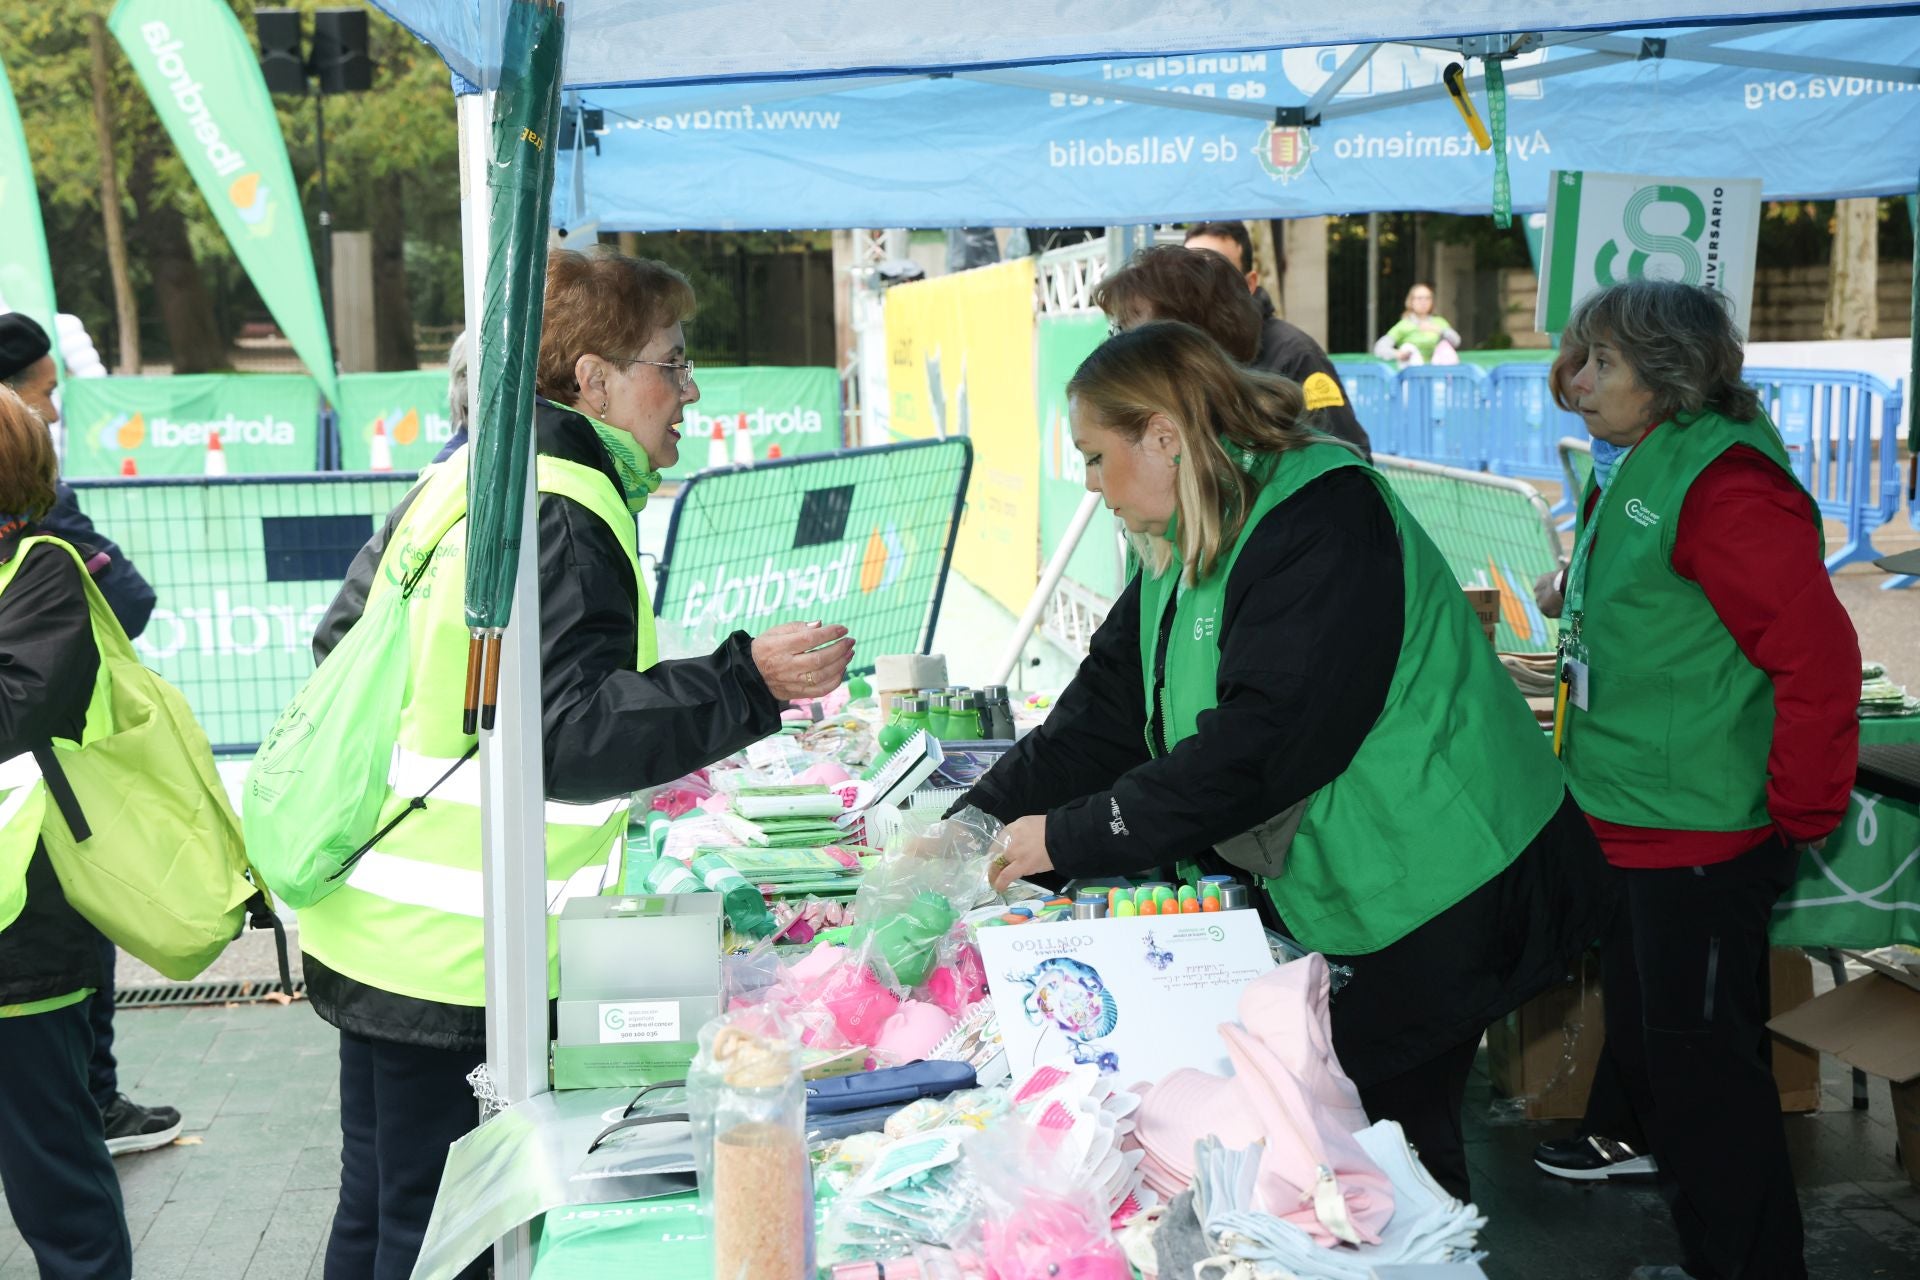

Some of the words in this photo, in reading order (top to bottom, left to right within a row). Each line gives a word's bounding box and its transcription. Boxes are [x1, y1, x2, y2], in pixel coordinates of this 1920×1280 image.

[1706, 186, 1724, 289] NIVERSARIO
[150, 412, 295, 448] Iberdrola
[1011, 935, 1094, 952] CONTIGO
